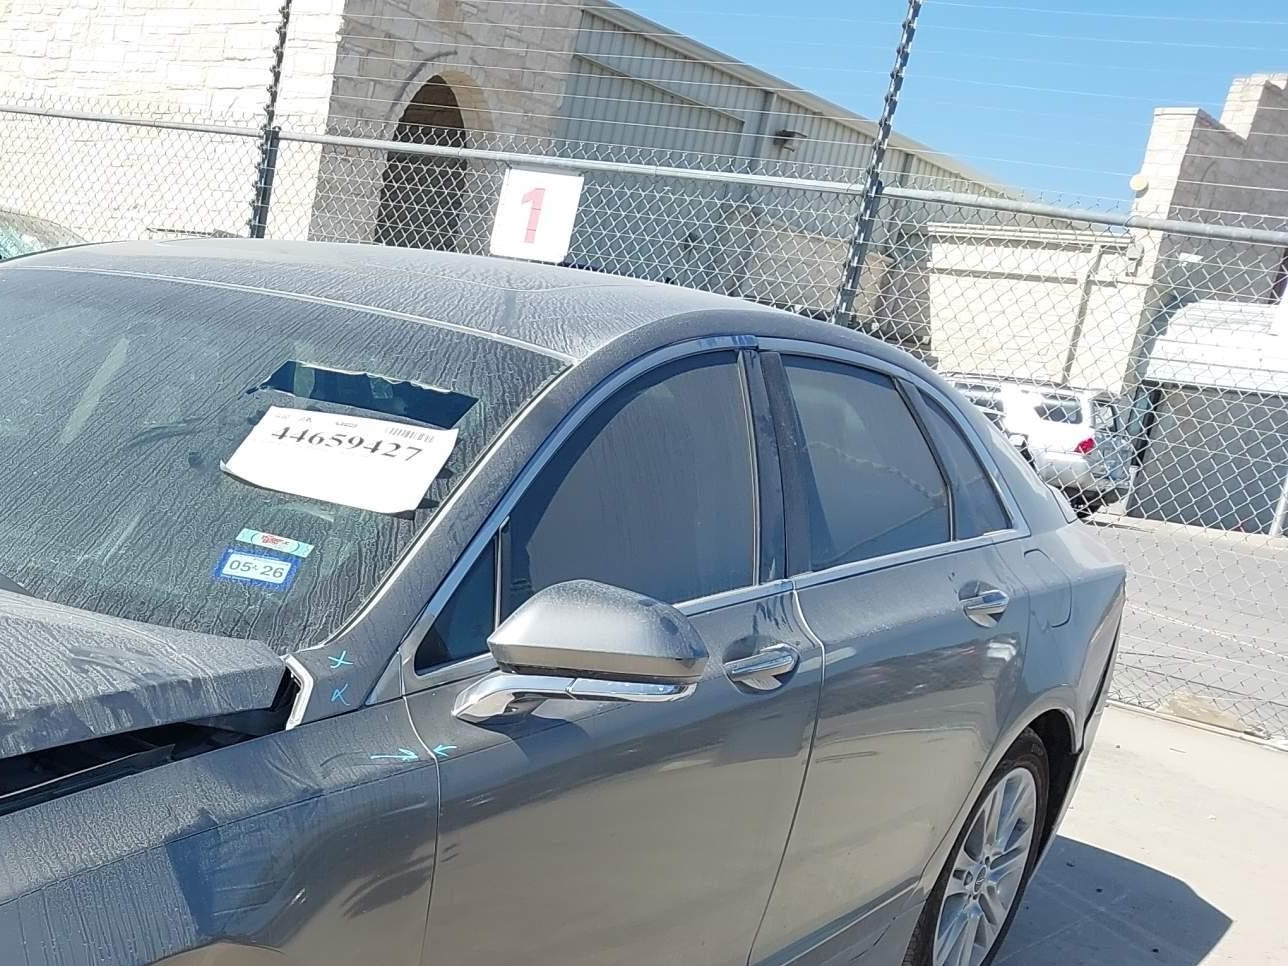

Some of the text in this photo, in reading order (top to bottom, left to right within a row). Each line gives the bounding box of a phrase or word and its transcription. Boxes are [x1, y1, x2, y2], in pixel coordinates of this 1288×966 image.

[520, 187, 547, 244] 1
[271, 426, 424, 461] 44659427
[229, 559, 285, 578] 05 26
